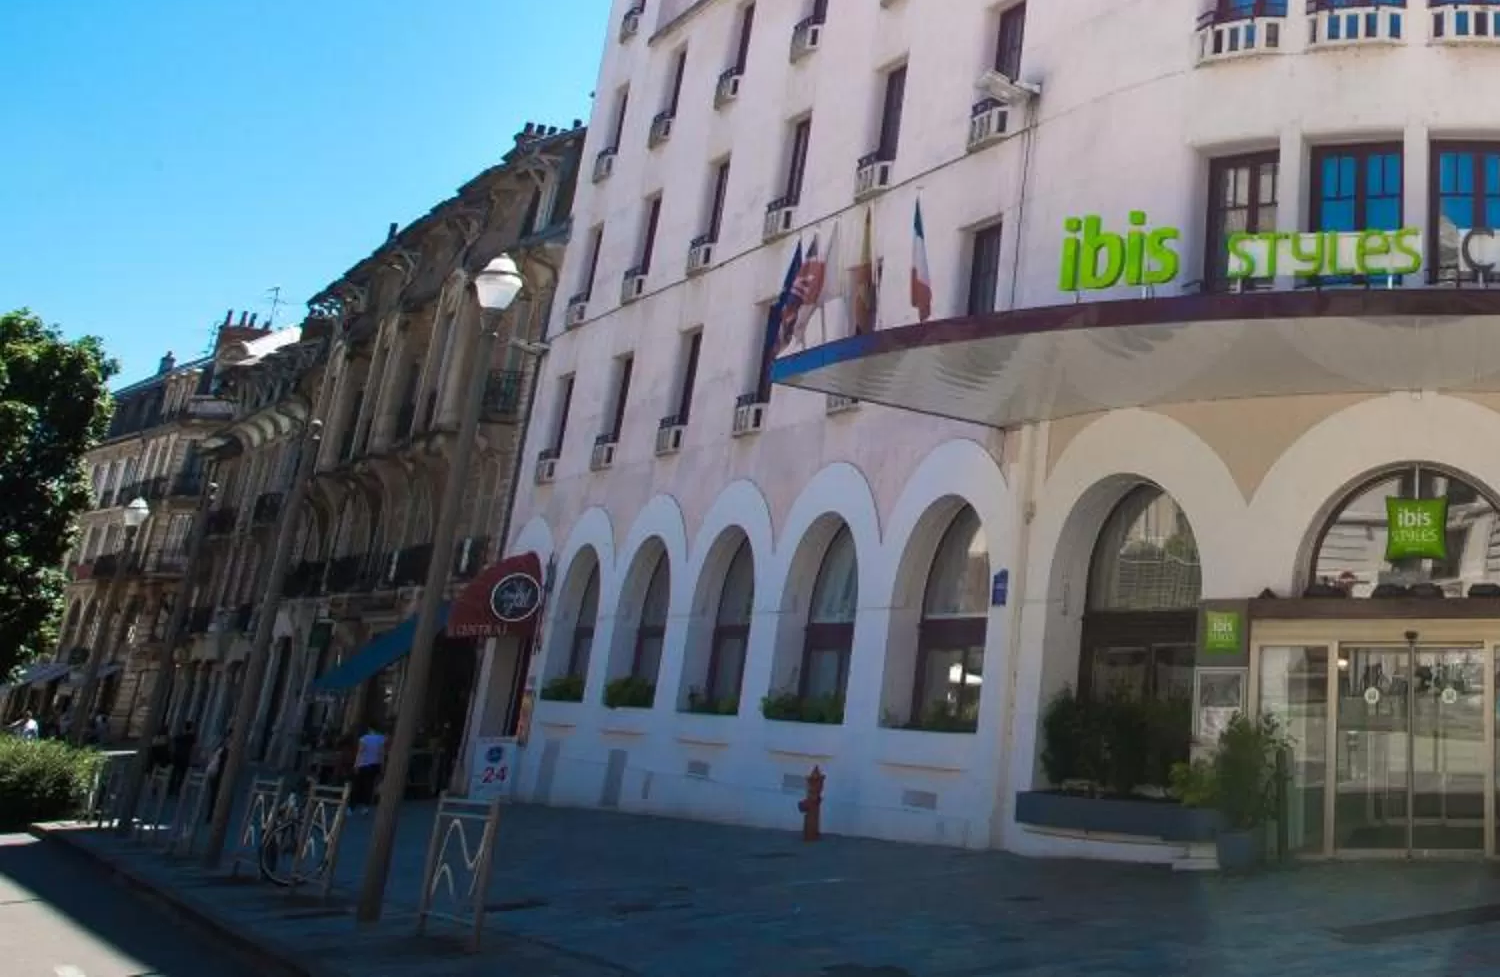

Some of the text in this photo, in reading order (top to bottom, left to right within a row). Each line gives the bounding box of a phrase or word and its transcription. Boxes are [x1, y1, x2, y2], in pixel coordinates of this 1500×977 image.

[1059, 210, 1180, 291] ibis
[1397, 507, 1432, 527] ibis
[482, 765, 508, 784] 24
